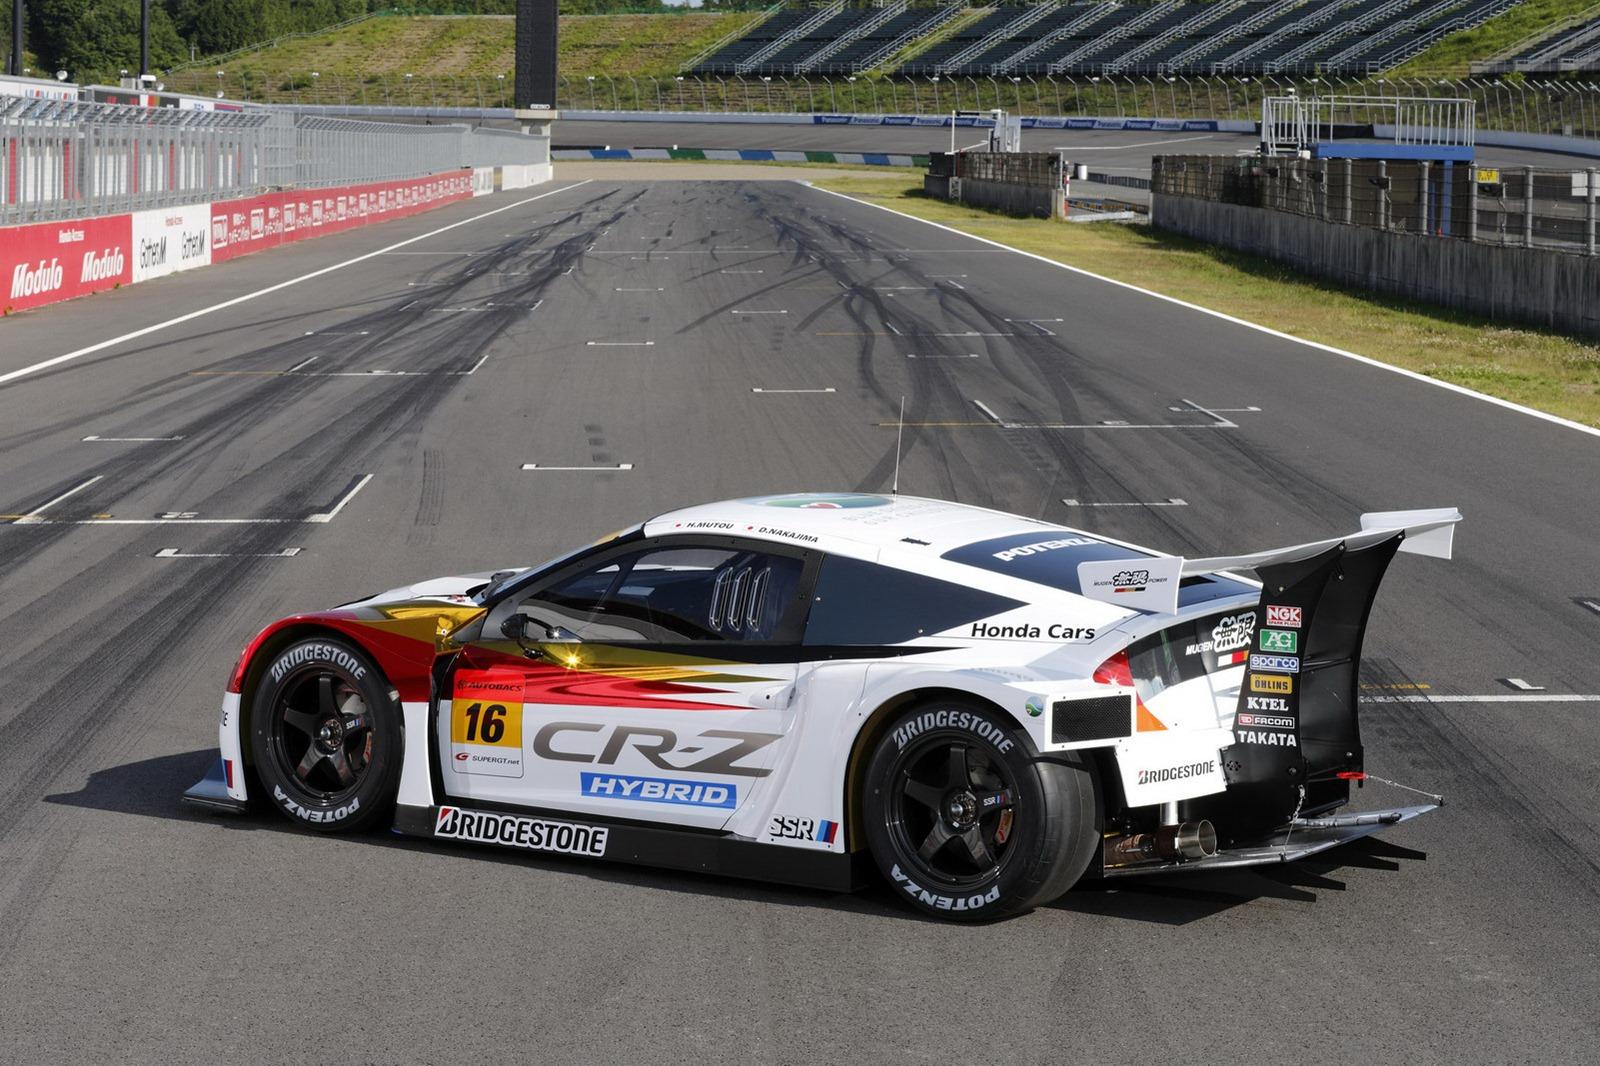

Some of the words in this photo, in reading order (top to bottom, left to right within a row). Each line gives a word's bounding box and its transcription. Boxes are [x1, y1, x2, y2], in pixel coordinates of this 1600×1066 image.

[80, 246, 125, 283] Modulo
[10, 257, 64, 299] Modulo
[758, 526, 820, 544] D.NAKAJIMA
[1268, 607, 1300, 622] NGK
[971, 623, 1040, 640] Honda
[1047, 624, 1096, 640] Cars
[1264, 631, 1292, 648] AG
[1185, 640, 1214, 656] MUGEN
[271, 644, 368, 684] BRIDGESTONE
[1252, 657, 1298, 670] sparco
[467, 682, 523, 692] AUTOBACS
[1247, 697, 1289, 712] KTEL
[465, 703, 507, 744] 16
[893, 710, 1014, 755] BRIDGESTONE
[1254, 716, 1294, 727] FACOM
[533, 721, 785, 778] CR-Z
[1238, 731, 1297, 747] TAKATA
[1138, 760, 1215, 785] BRIDGESTONE
[589, 776, 729, 804] HYBRID
[272, 784, 361, 824] POTENZA
[434, 807, 607, 855] BRIDGESTONE
[768, 813, 814, 841] SSR
[890, 864, 1001, 911] POTENZA
